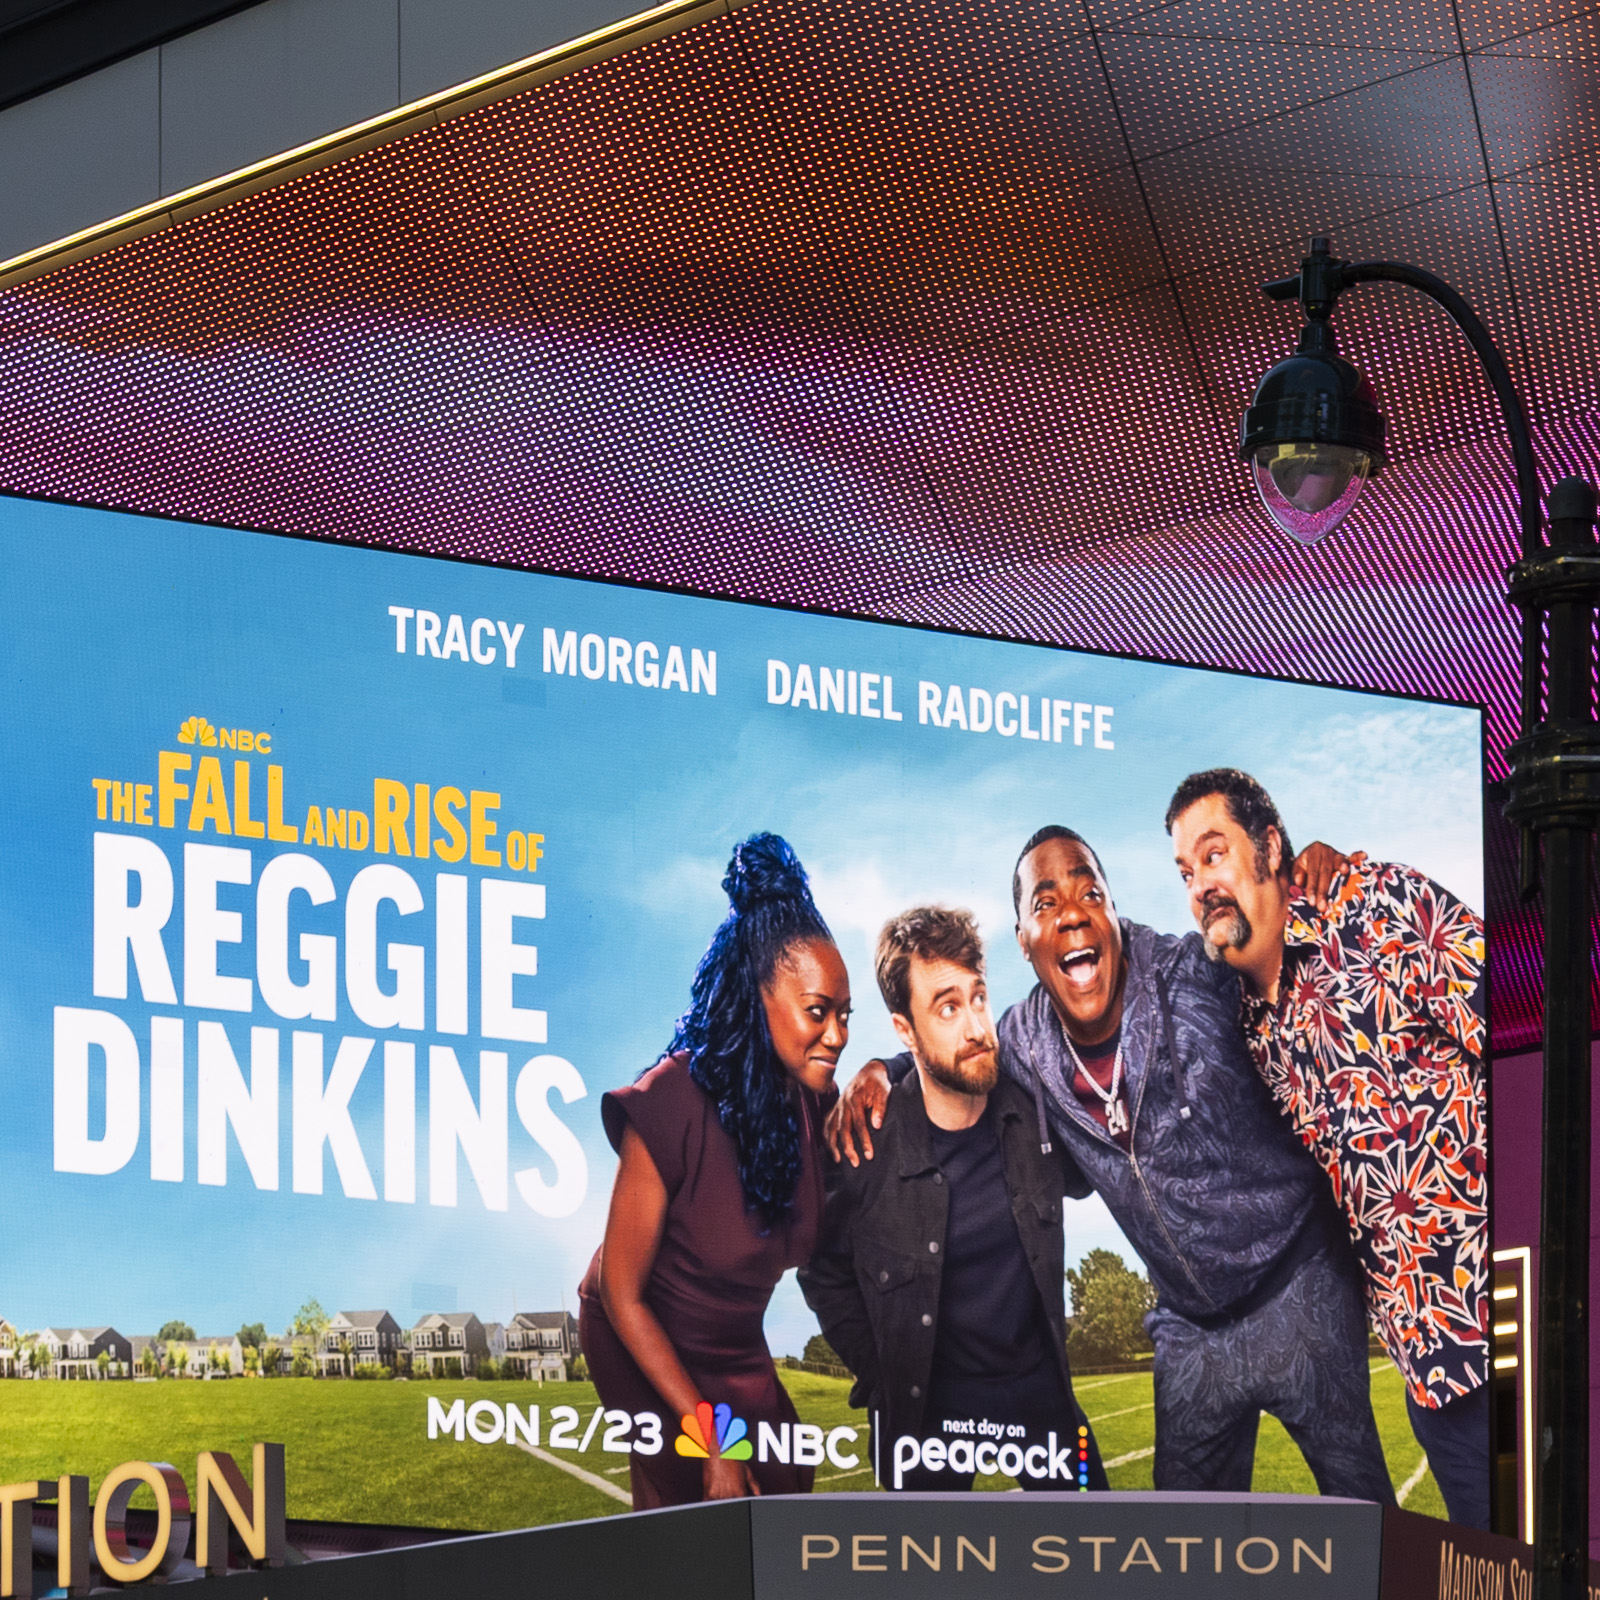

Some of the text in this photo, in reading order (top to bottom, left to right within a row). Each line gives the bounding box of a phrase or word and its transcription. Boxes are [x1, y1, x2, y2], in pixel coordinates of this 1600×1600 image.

[388, 605, 1116, 752] TRACY MORGAN DANIEL RADCLIFFE
[219, 727, 272, 755] NBC
[92, 750, 546, 873] THE FALL AND RISE OF
[92, 831, 548, 1045] REGGIE
[52, 1005, 589, 1220] DINKINS
[1105, 1100, 1128, 1136] 24
[427, 1396, 860, 1470] MON 2/23 NBC
[893, 1432, 1073, 1490] peacock
[942, 1419, 1026, 1441] next day on
[801, 1534, 1334, 1575] PENN STATION
